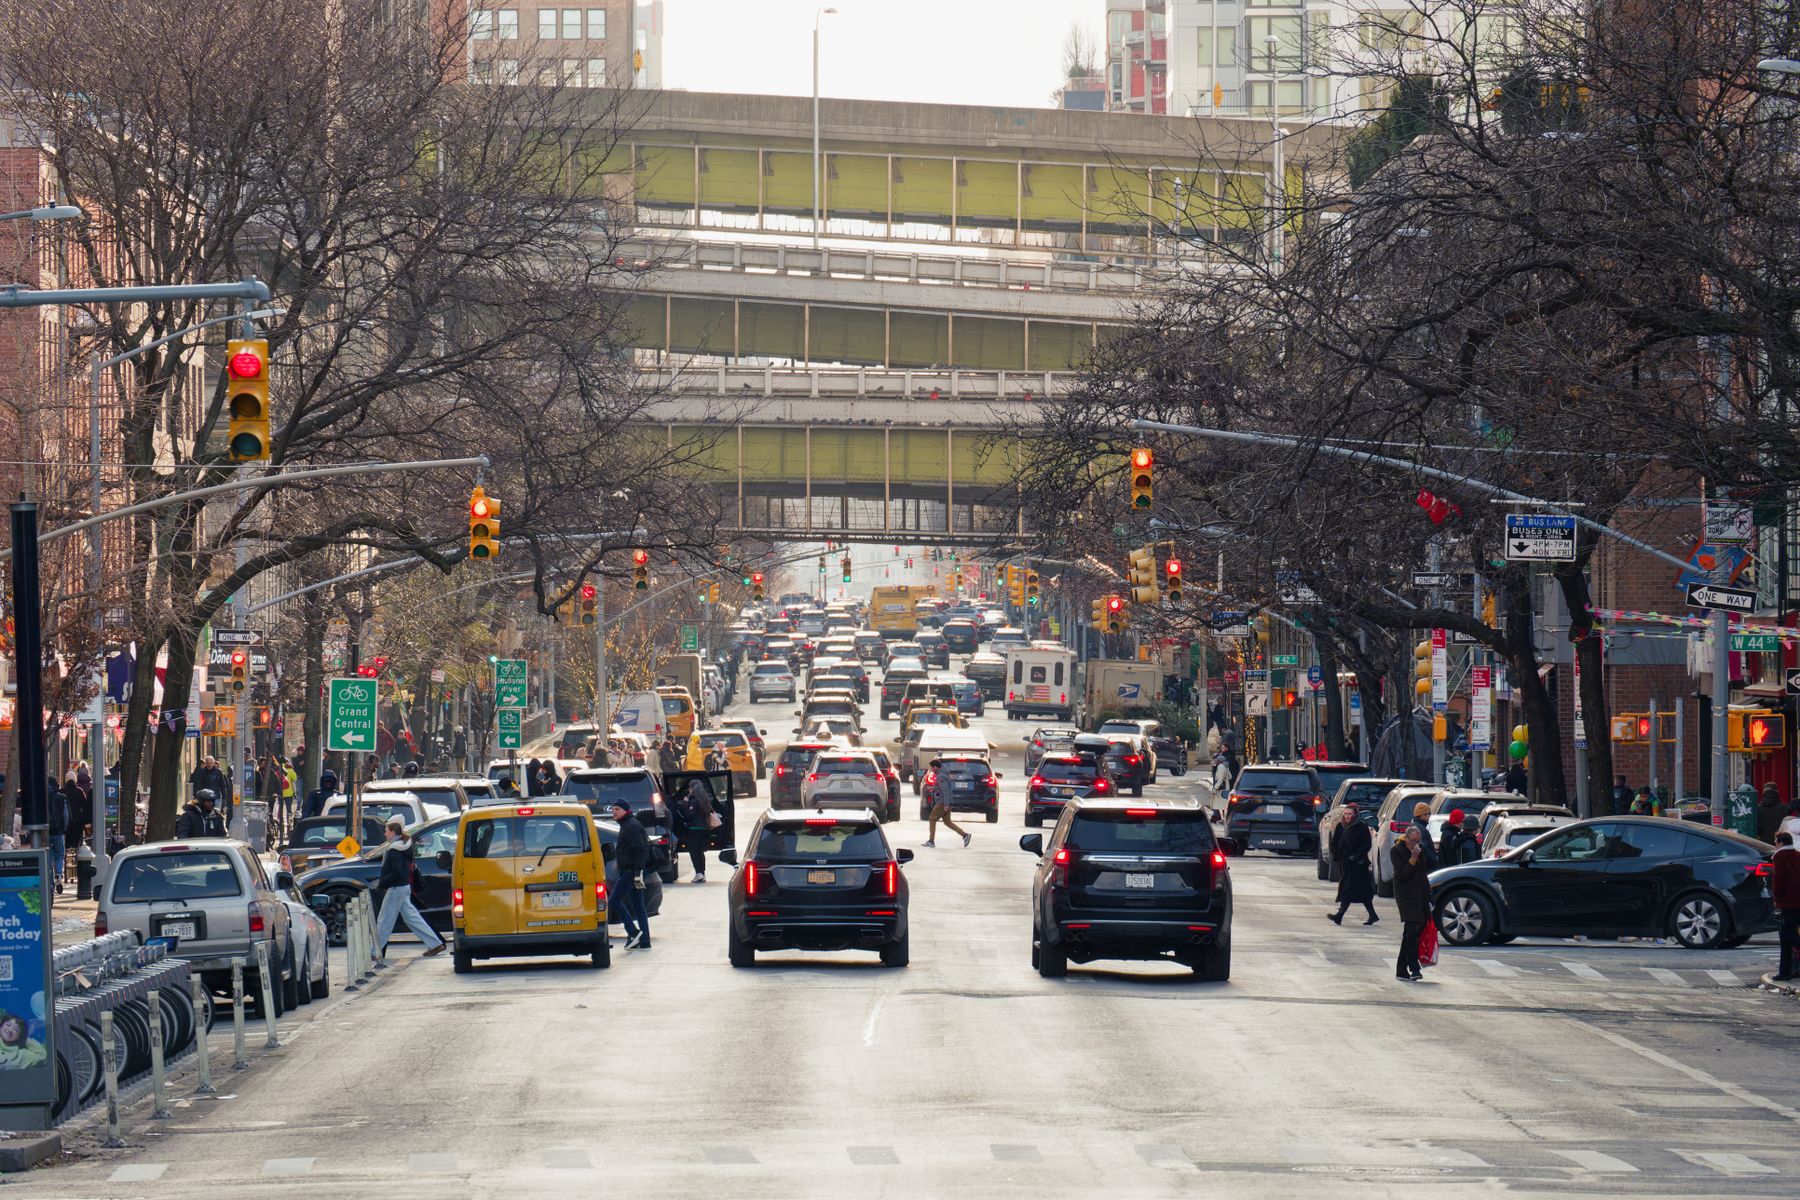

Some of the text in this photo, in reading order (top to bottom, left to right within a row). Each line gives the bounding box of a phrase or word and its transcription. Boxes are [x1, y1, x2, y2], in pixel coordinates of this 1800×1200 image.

[1528, 518, 1544, 526] BUS
[1545, 528, 1570, 536] ONLY
[1697, 591, 1748, 605] ONE WAY
[1734, 637, 1744, 649] W
[1748, 637, 1764, 649] 44
[339, 706, 368, 717] Grand
[1576, 712, 1582, 720] 2
[335, 718, 371, 728] Central
[1, 928, 41, 941] Today
